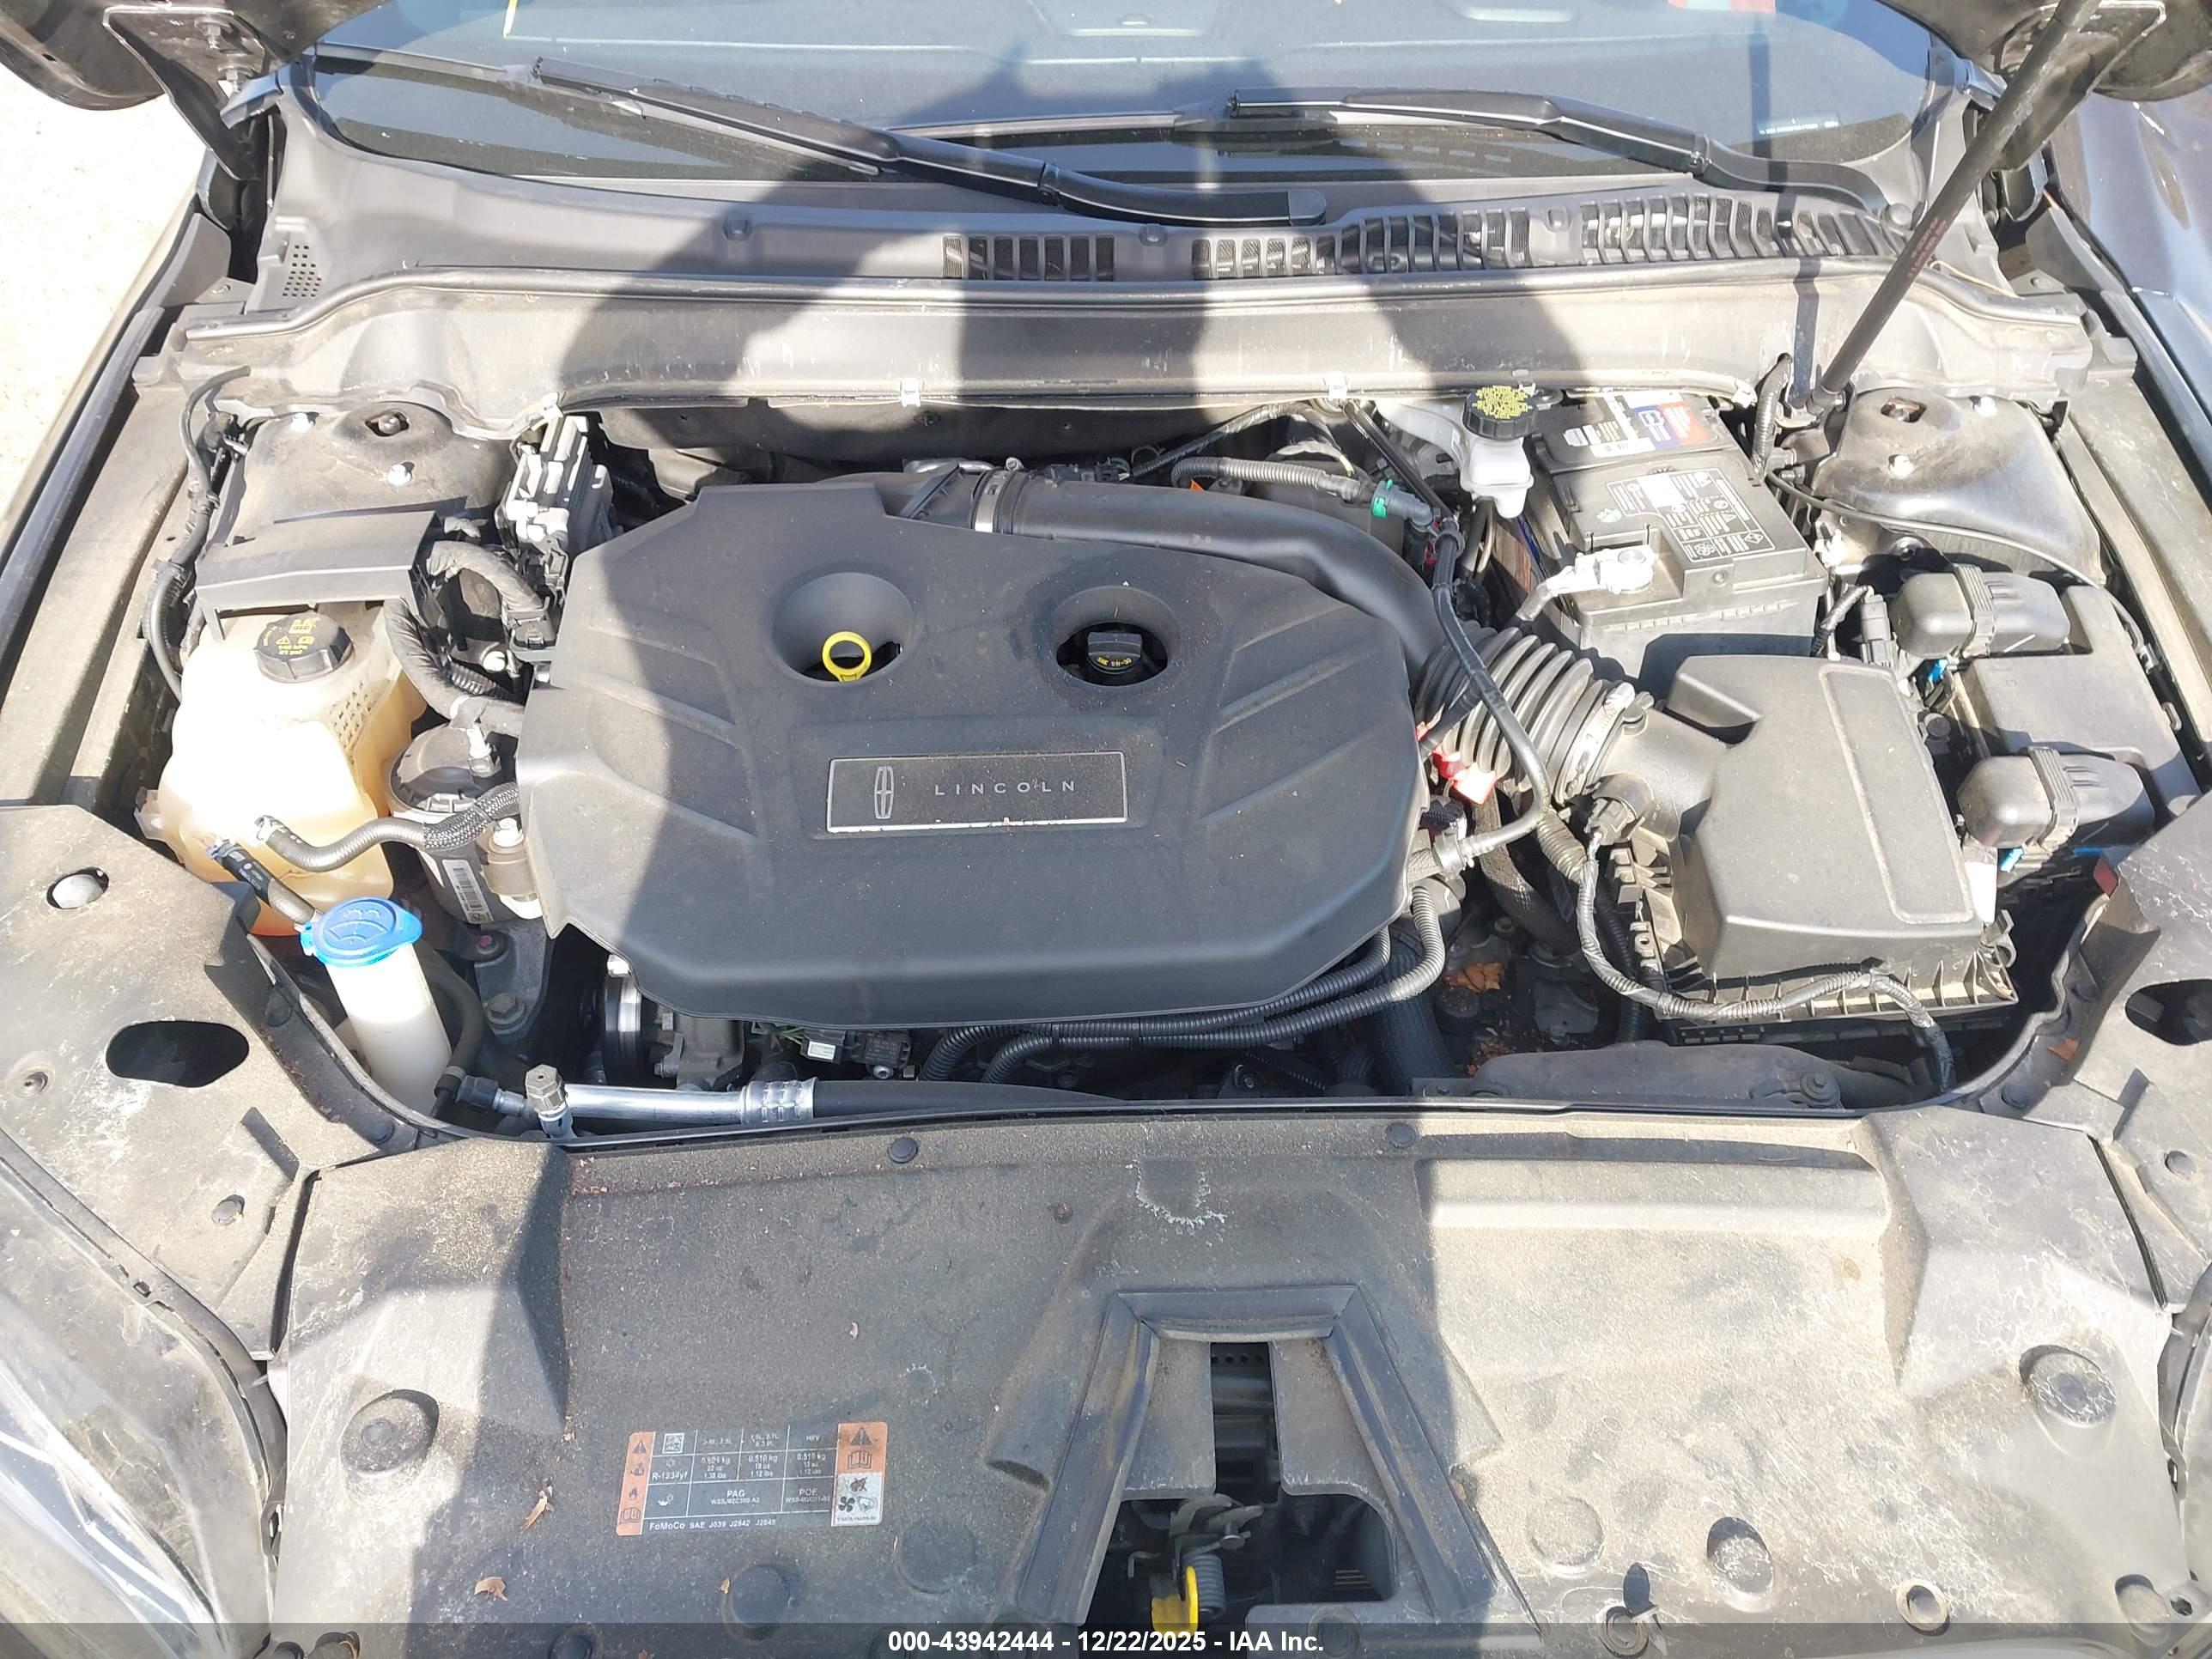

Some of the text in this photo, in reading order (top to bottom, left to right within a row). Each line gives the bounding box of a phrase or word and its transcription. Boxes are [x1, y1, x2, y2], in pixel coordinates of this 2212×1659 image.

[933, 780, 1076, 797] LINCOLN
[721, 1456, 731, 1465] kg
[768, 1454, 778, 1463] kg
[817, 1452, 826, 1462] kg
[652, 1470, 688, 1481] R-1234yf
[726, 1489, 745, 1498] PAG
[649, 1521, 685, 1531] FoMoCo
[689, 1521, 706, 1529] SAE
